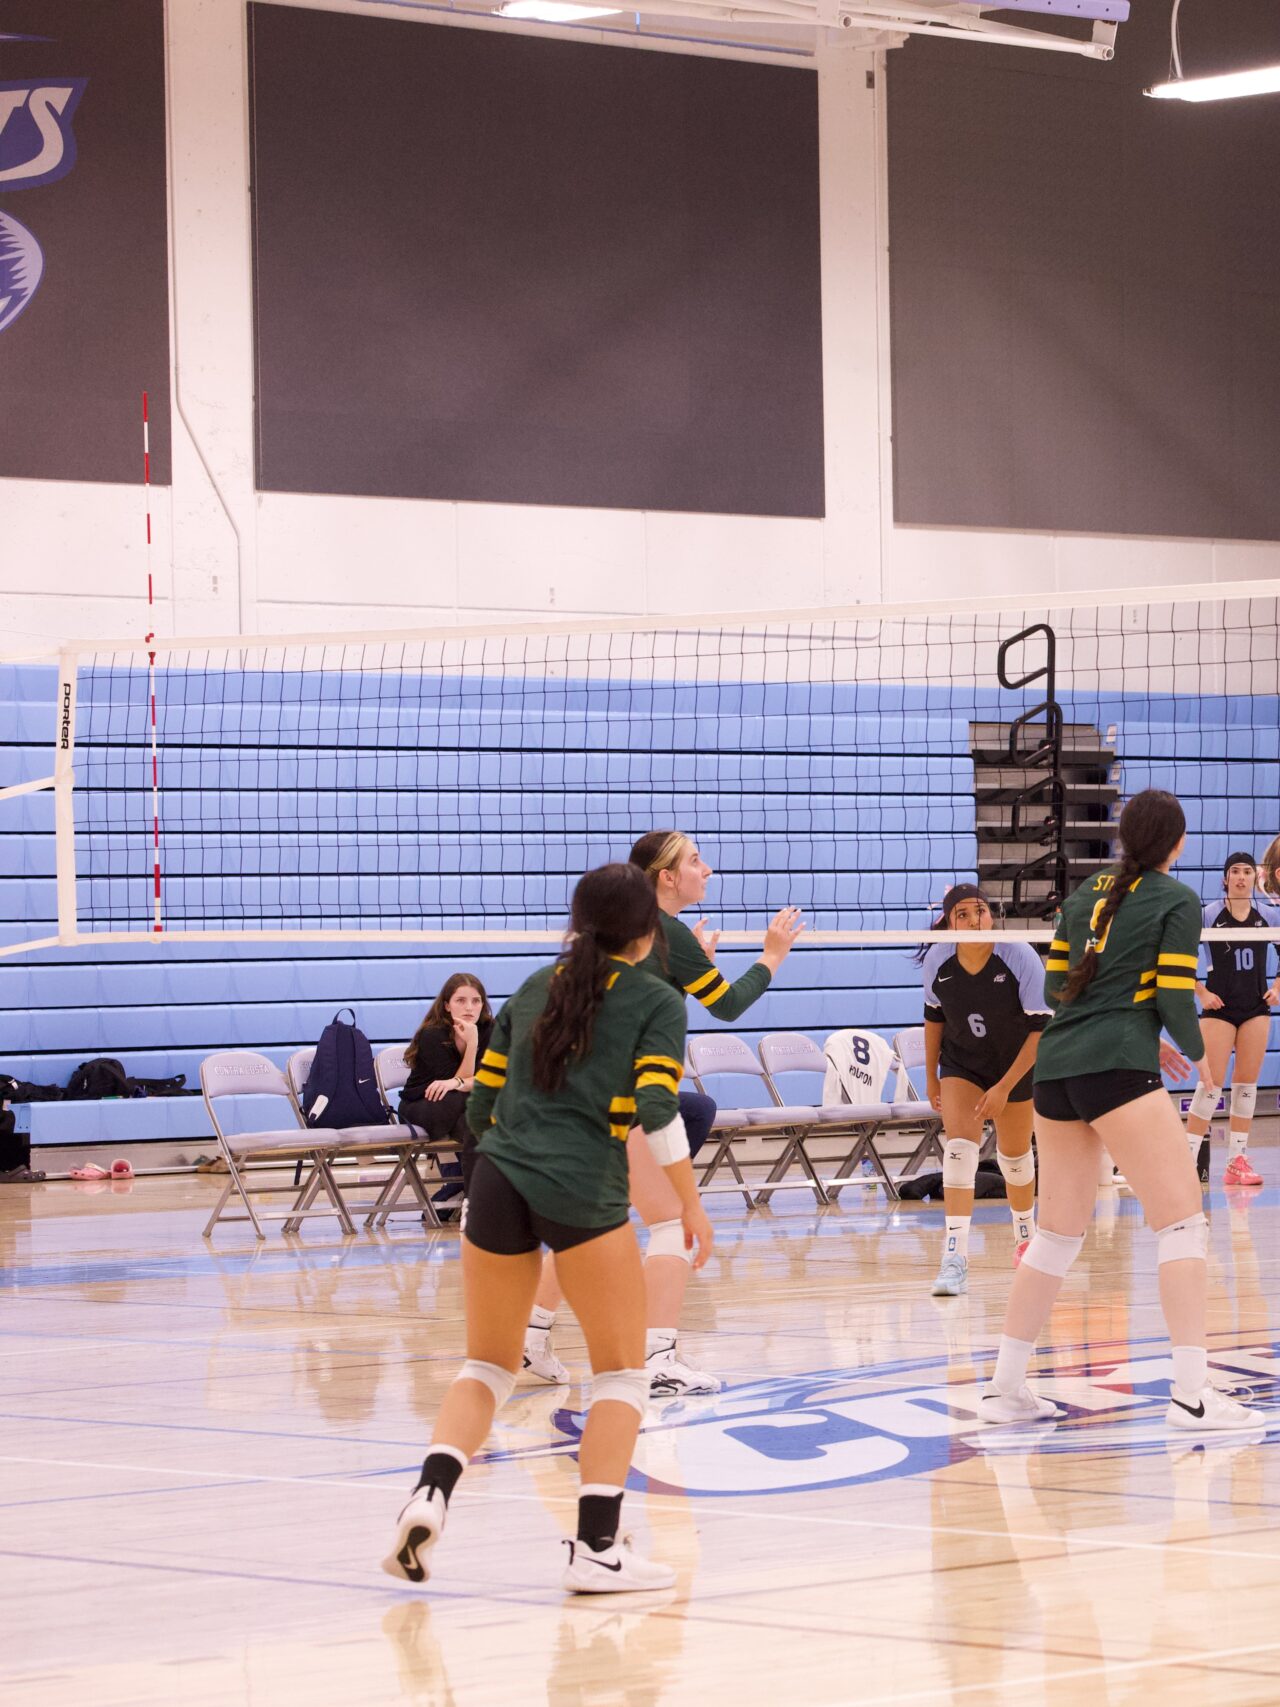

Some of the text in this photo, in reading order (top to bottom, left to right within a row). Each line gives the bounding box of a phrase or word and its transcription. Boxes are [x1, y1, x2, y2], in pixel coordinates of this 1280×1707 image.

[1234, 948, 1254, 971] 10
[967, 1013, 987, 1038] 6
[852, 1035, 871, 1066] 8
